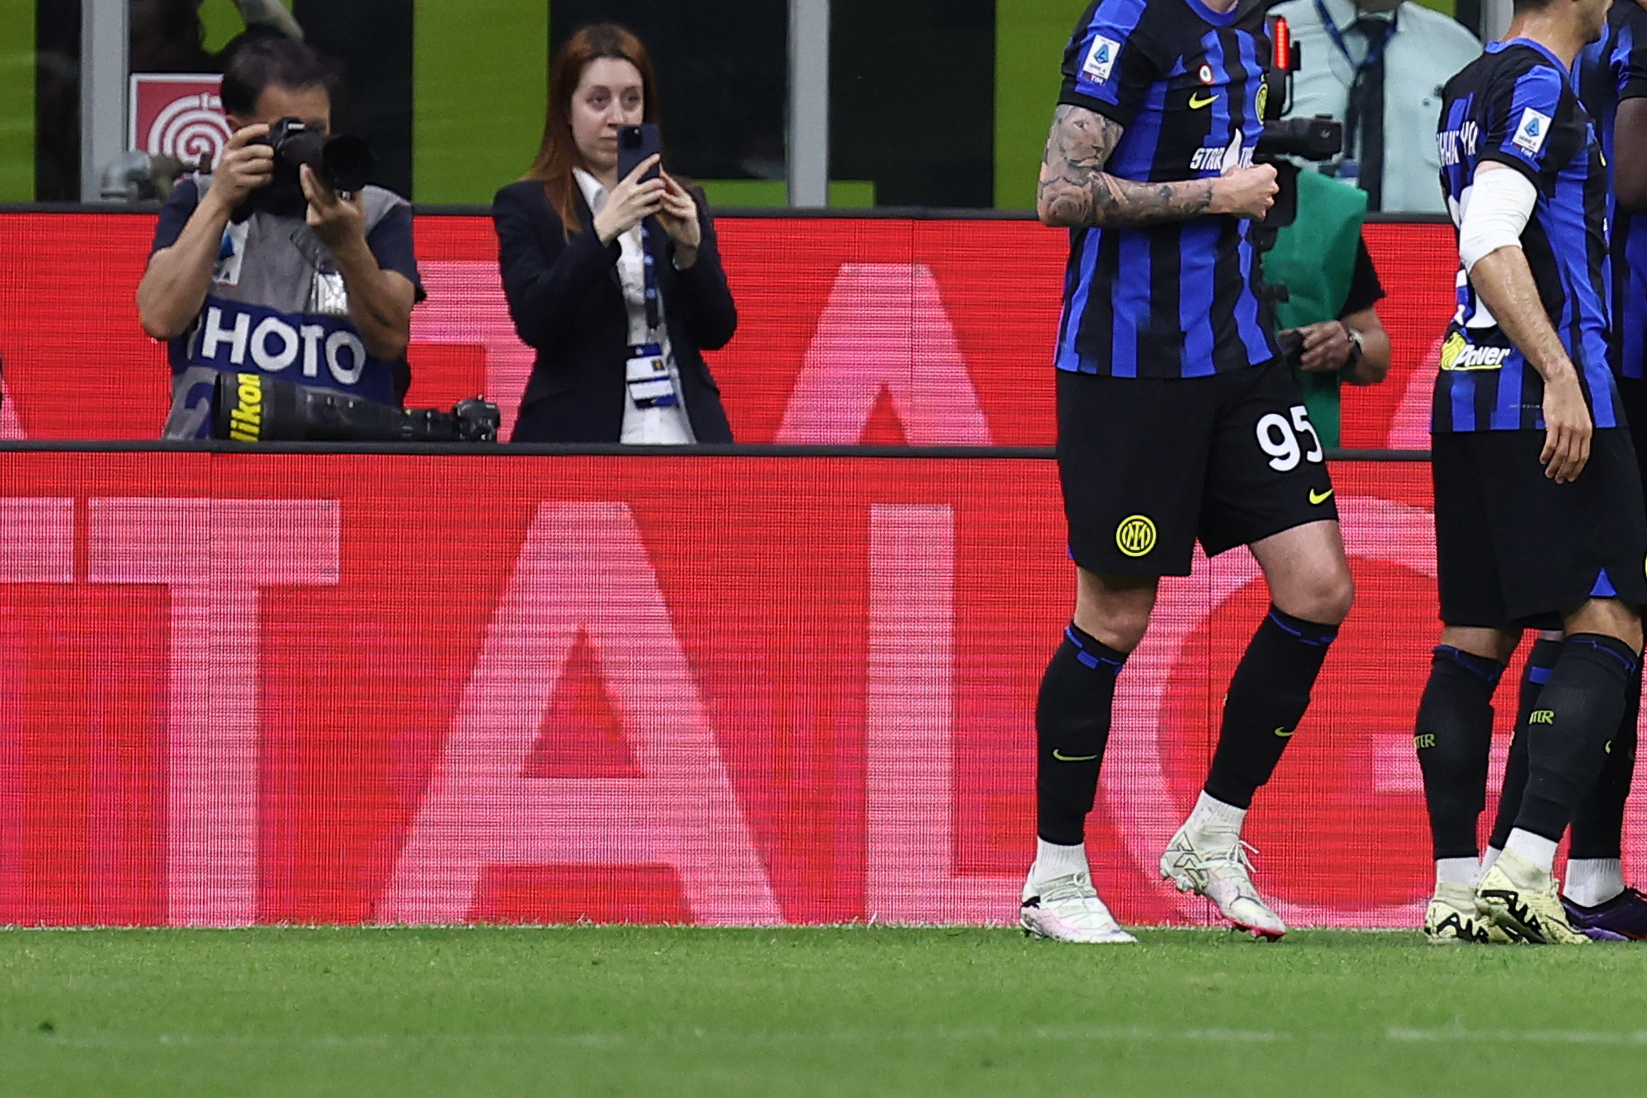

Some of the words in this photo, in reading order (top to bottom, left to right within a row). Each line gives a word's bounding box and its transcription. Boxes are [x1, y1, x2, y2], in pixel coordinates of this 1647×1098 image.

[1189, 147, 1226, 170] STAR
[187, 304, 366, 384] HOTO
[1255, 405, 1323, 472] 95
